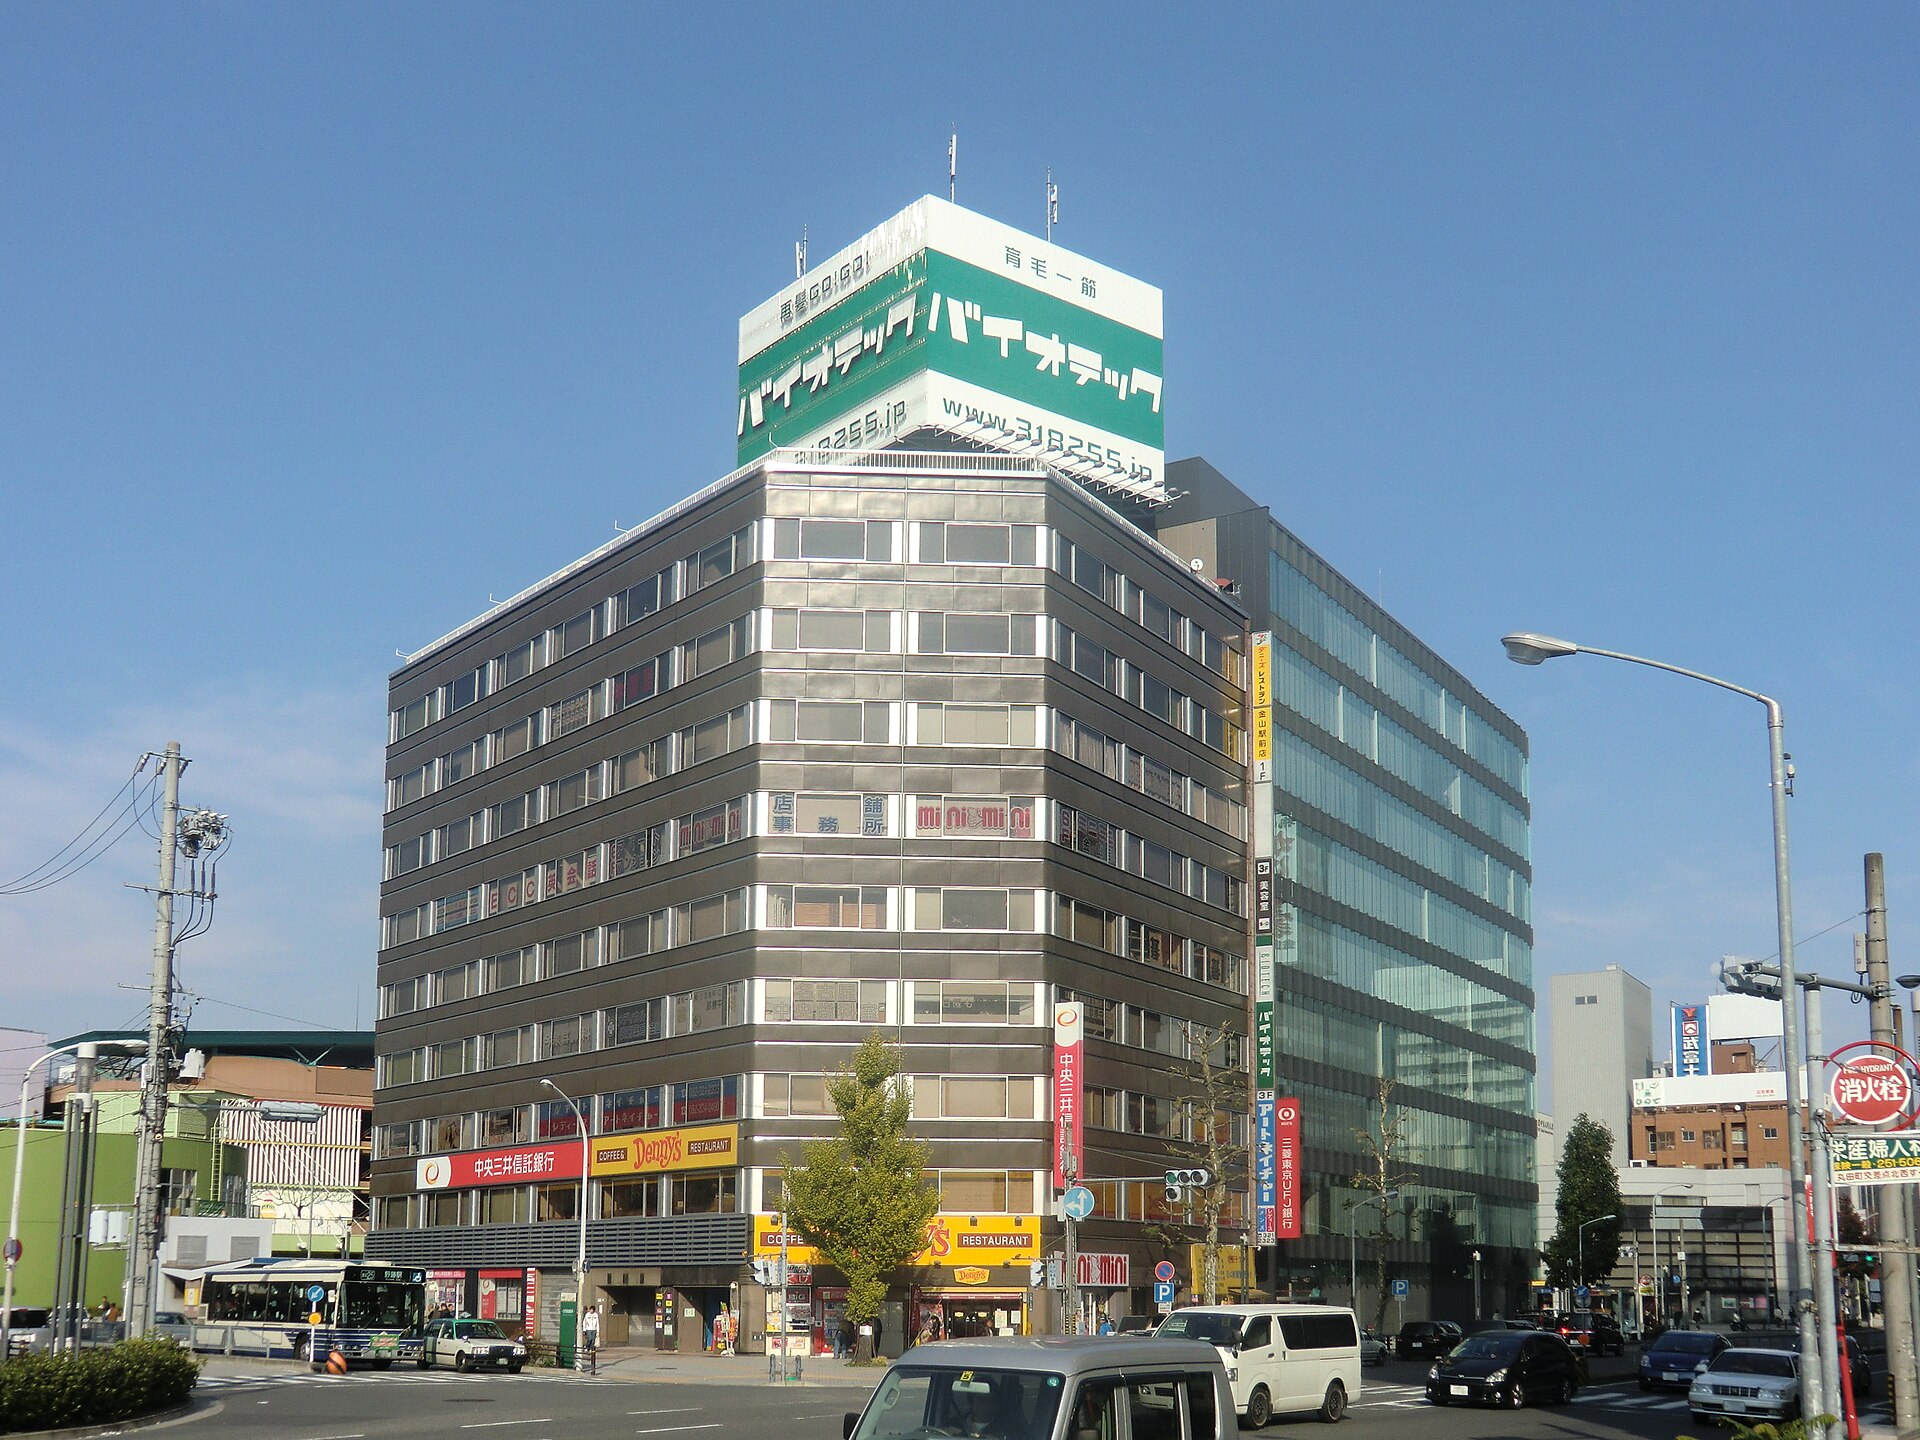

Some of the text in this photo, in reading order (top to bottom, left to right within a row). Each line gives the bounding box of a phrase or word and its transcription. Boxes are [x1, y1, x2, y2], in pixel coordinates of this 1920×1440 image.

[1004, 246, 1096, 298] 育毛一筋
[737, 292, 917, 437] バイオテック
[927, 291, 1163, 413] バイオテック
[943, 398, 1152, 483] www318255.jp
[1258, 709, 1267, 758] 金山駅前店
[1258, 864, 1269, 873] 3F
[1259, 881, 1269, 911] 美容室
[1259, 1011, 1273, 1077] バイオテック
[1861, 1064, 1893, 1073] HYDRANT
[1839, 1075, 1904, 1104] 消火栓
[632, 1131, 682, 1169] Denny's
[690, 1140, 729, 1153] RESTAURANT
[1258, 1104, 1273, 1202] アートネイチャー
[474, 1151, 555, 1178] 中央三井信託銀行
[1837, 1169, 1920, 1181] 丸田町交差点北西す
[1281, 1138, 1293, 1229] 三菱東京UFJ銀行
[767, 1234, 805, 1245] COFFE
[962, 1235, 1029, 1246] RESTAURANT
[959, 1269, 986, 1281] Denny's
[1396, 1281, 1406, 1294] P
[1160, 1284, 1170, 1301] P
